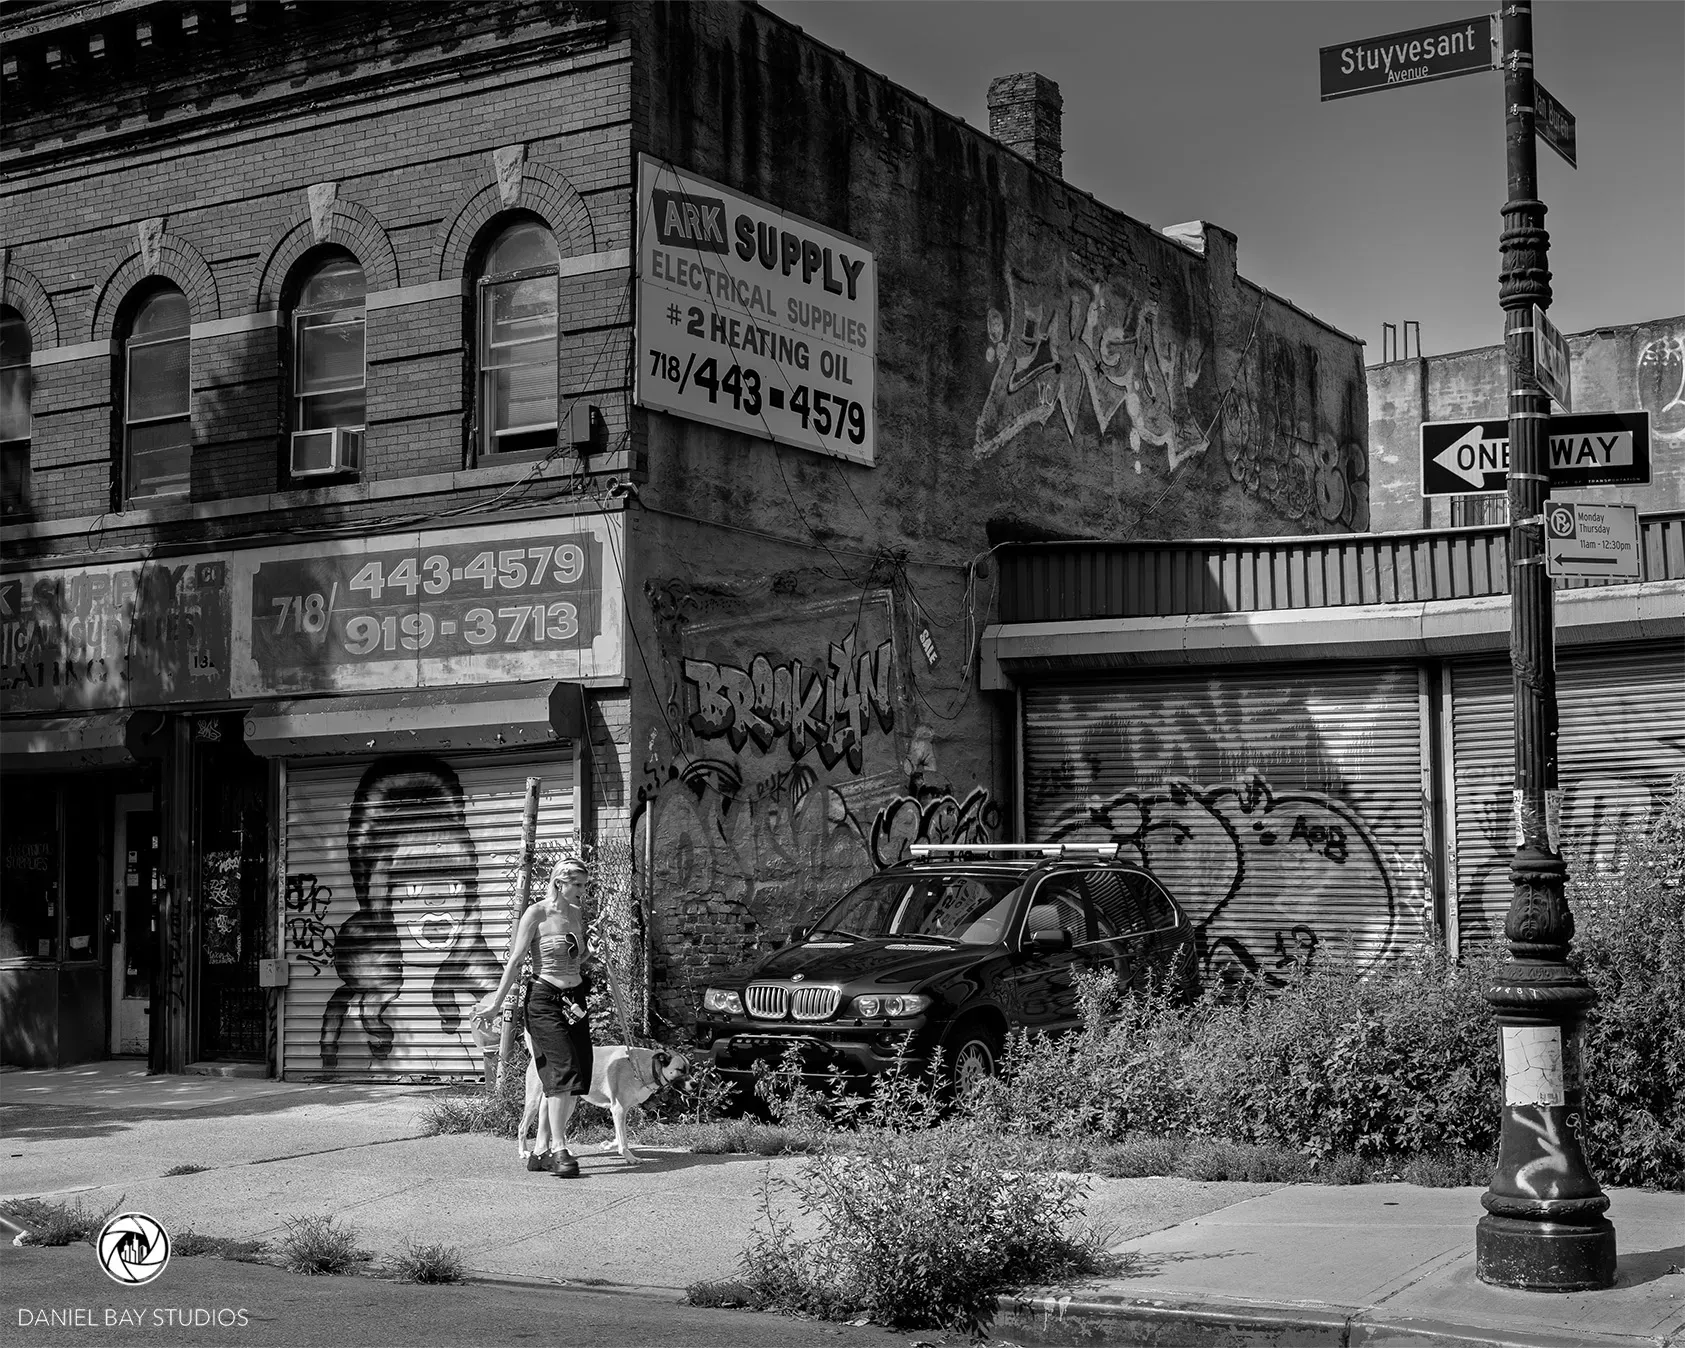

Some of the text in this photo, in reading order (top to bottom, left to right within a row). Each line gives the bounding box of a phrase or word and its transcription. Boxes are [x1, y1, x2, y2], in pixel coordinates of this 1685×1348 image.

[1340, 25, 1476, 75] Stuyvesant
[1387, 64, 1429, 83] Avenue
[663, 200, 866, 301] ARK SUPPLY
[651, 249, 868, 349] ELECTRICAL SUPPLIES
[710, 312, 810, 371] HEATING
[819, 350, 853, 385] OIL
[1550, 435, 1620, 466] WAY
[1578, 511, 1606, 524] Monday
[1579, 523, 1611, 535] Thursday
[1580, 539, 1597, 549] 11am
[1602, 540, 1632, 551] 12:30pm
[349, 544, 585, 599] 443-4579
[344, 602, 579, 655] 919-3713
[919, 628, 938, 666] SALE
